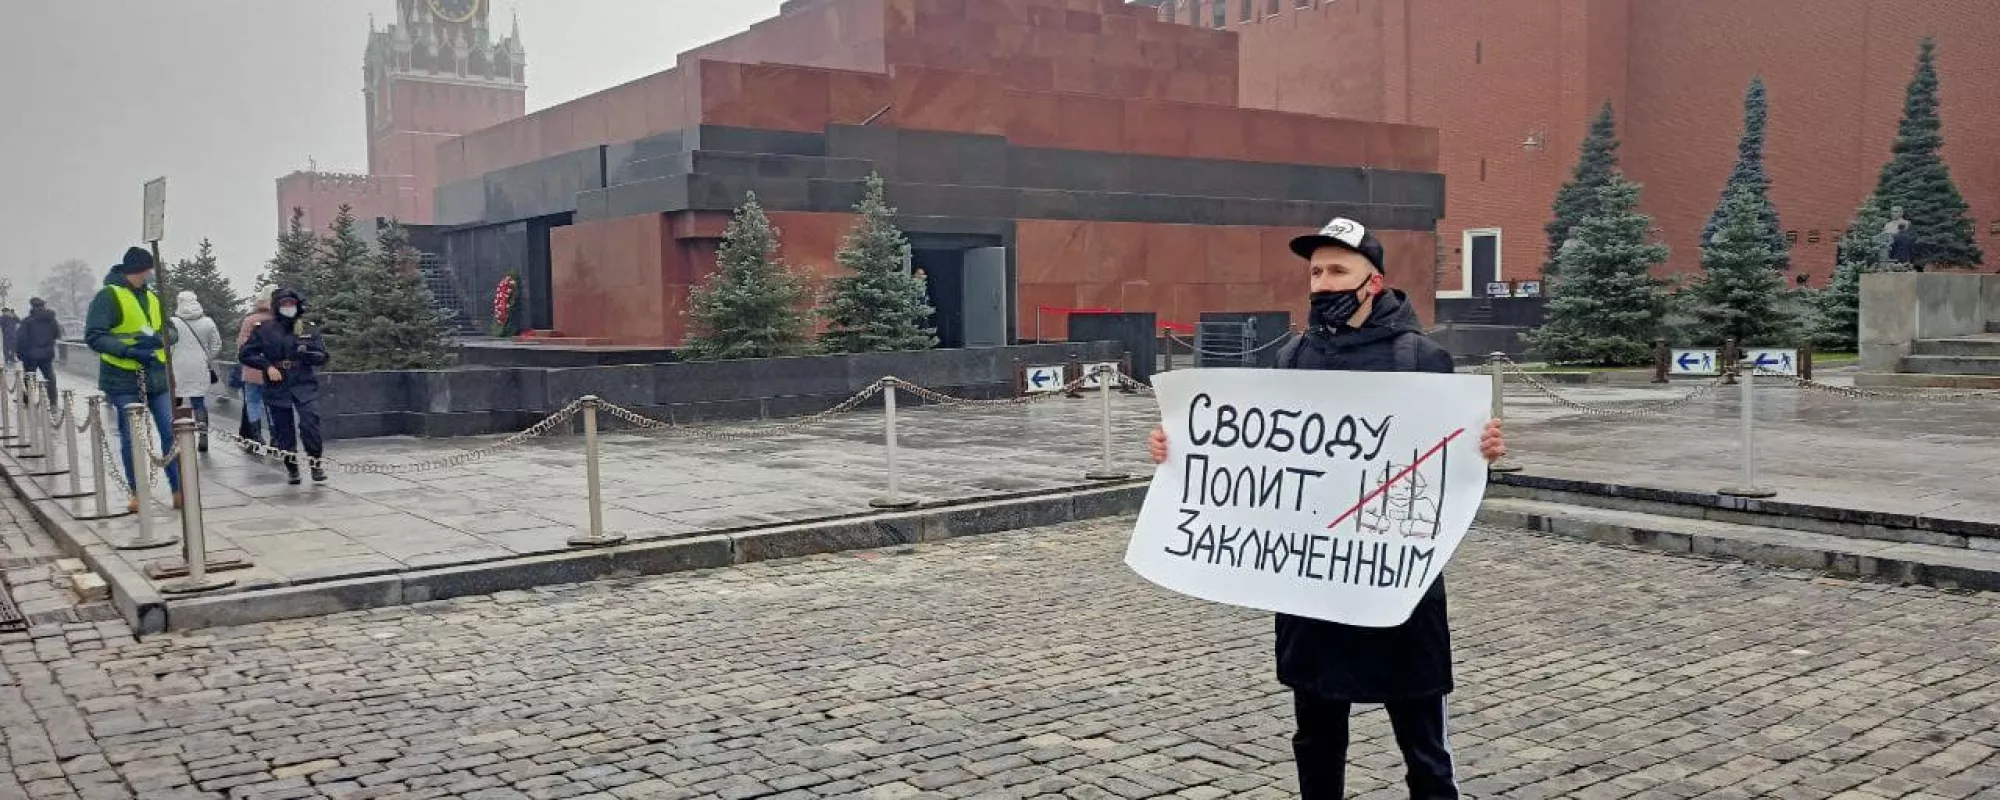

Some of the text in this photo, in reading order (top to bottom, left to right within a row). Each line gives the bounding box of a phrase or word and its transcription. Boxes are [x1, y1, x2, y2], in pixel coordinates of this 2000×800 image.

[1188, 393, 1394, 461] СВОБОДУ
[1182, 454, 1327, 515] ПОЛИТ.
[1164, 509, 1435, 588] ЗАКЛЮЧЕННЫМ
